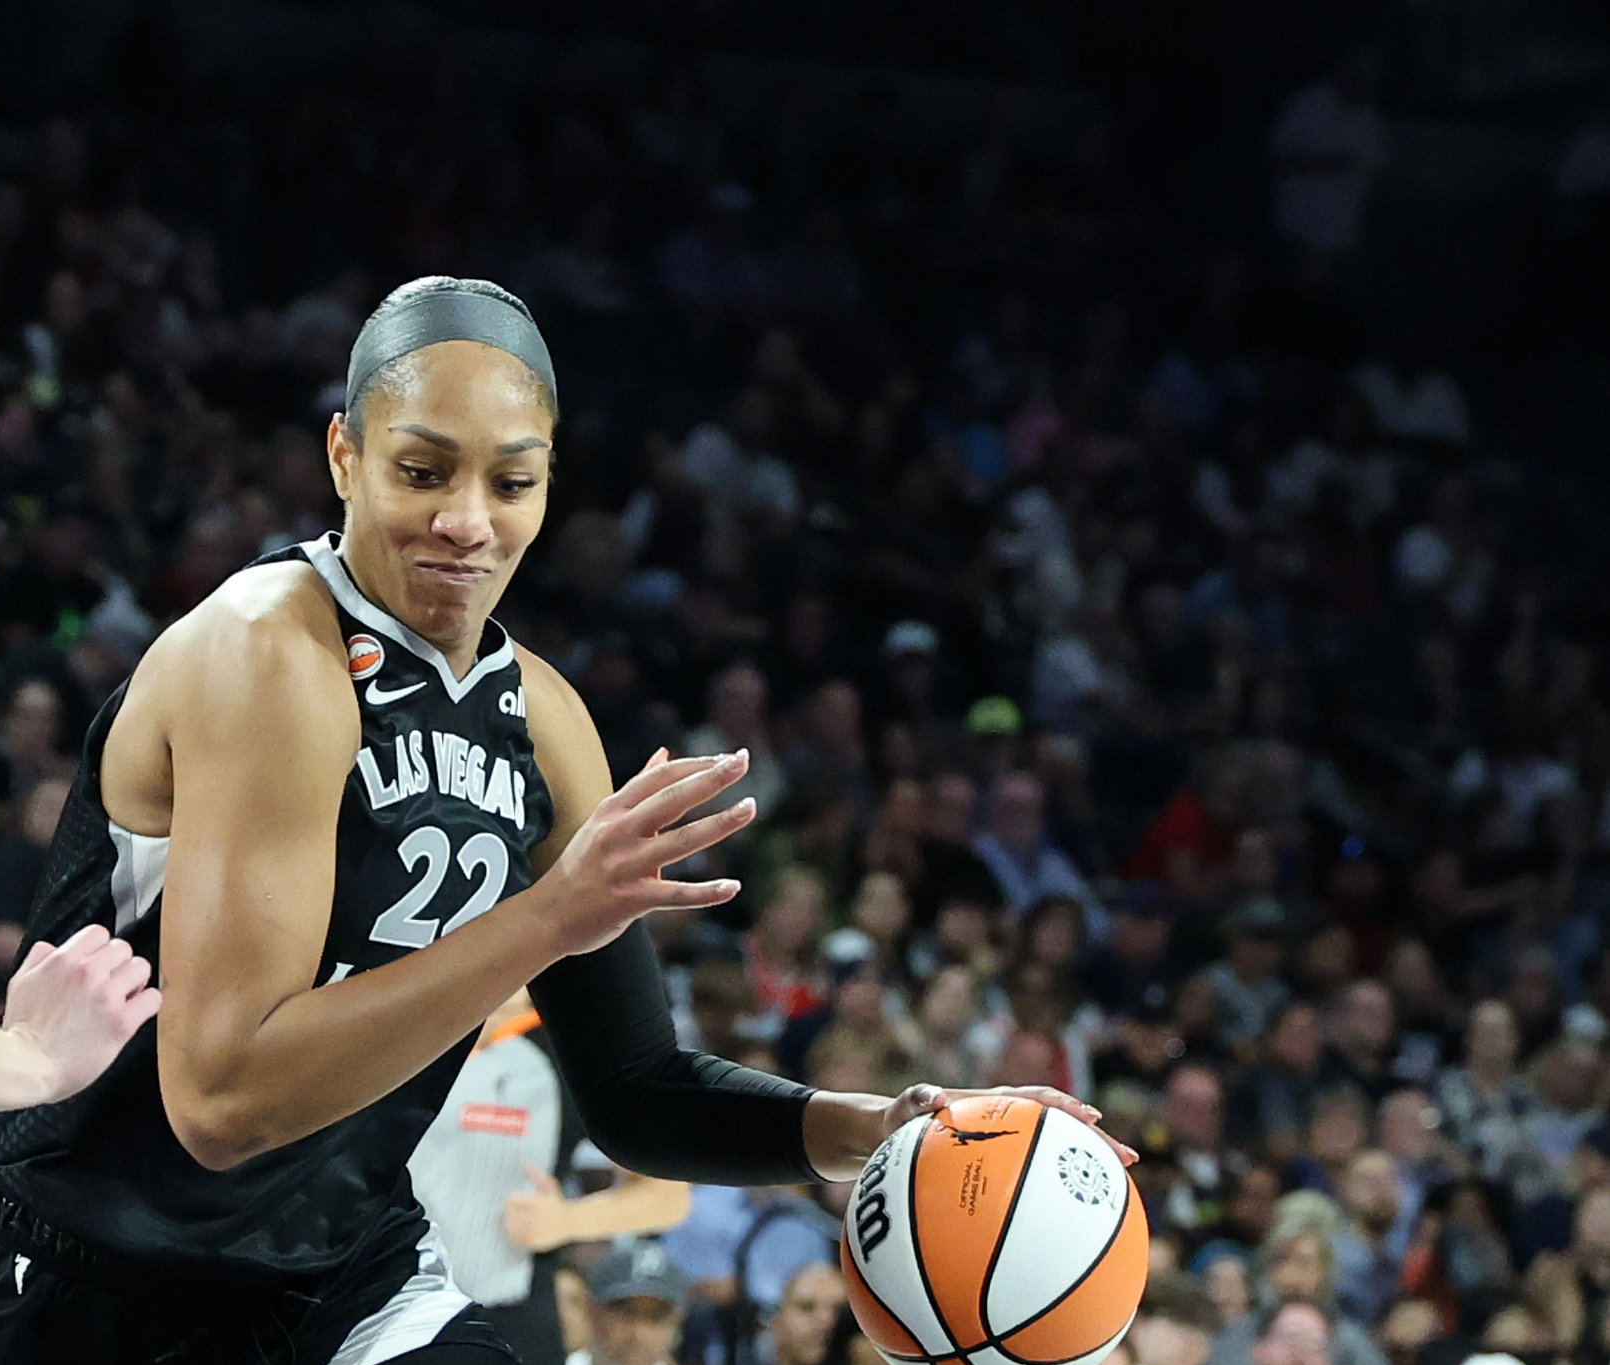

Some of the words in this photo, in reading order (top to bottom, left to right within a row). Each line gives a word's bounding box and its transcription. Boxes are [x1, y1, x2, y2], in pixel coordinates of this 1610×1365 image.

[356, 730, 430, 811] LAS
[431, 730, 526, 830] VEGAS
[368, 825, 509, 949] 22
[959, 1161, 973, 1208] OFFICIAL
[967, 1182, 979, 1216] GAME
